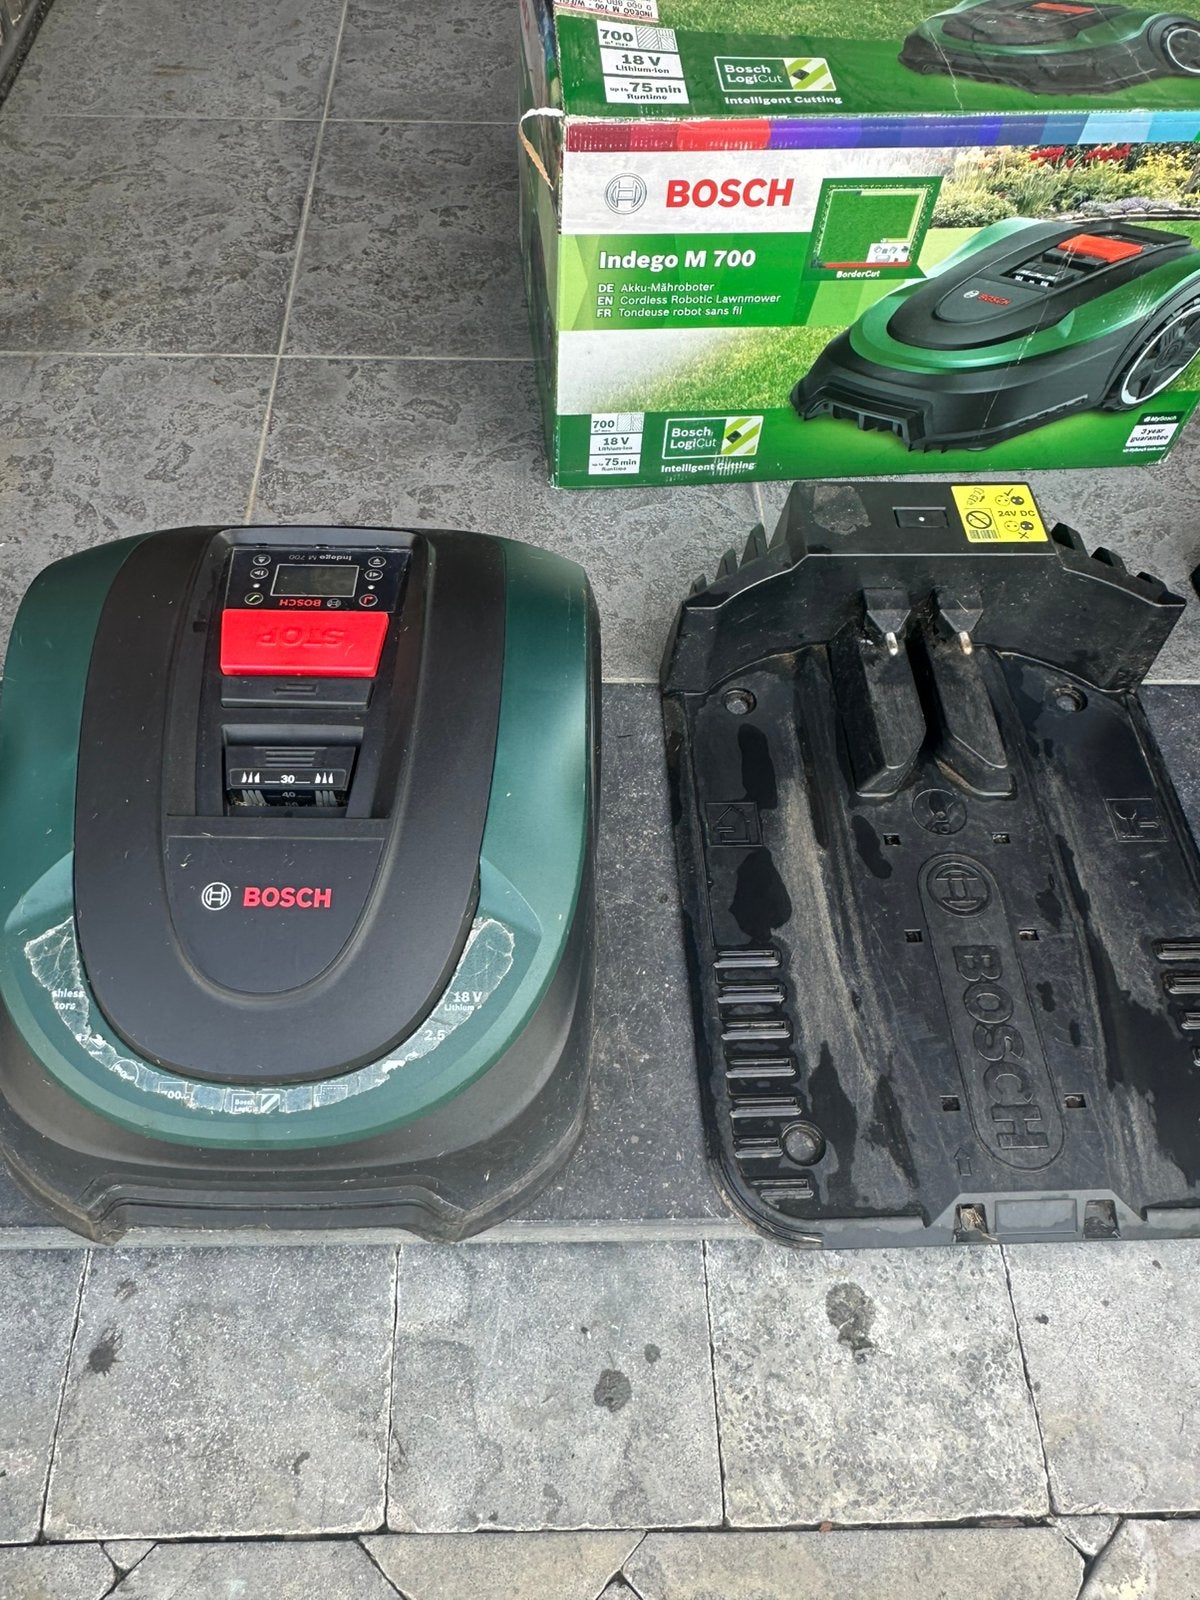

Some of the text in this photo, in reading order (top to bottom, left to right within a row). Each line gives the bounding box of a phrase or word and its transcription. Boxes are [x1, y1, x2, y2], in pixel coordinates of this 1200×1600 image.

[600, 29, 633, 42] 700
[621, 54, 661, 66] 18 V
[723, 63, 771, 75] Bosch
[726, 73, 783, 85] LogiCut
[629, 82, 653, 93] 75
[655, 85, 682, 94] min
[725, 95, 843, 106] Intelligent Cutting
[665, 178, 795, 208] BOSCH
[598, 249, 756, 273] Indego M 700
[836, 270, 881, 279] BorderCut
[598, 282, 715, 293] DE Akku-Mähroboter
[597, 294, 782, 306] EN Cordless Robotic Lawnmower
[597, 306, 743, 318] FR Tondeuse robot sans fil
[593, 420, 615, 429] 700
[671, 426, 711, 437] Bosch
[603, 437, 630, 446] 18 V
[670, 438, 717, 450] LogiCut
[1130, 435, 1169, 443] guarantee
[605, 458, 619, 466] 75
[661, 461, 755, 473] Intelligent Cutting
[279, 599, 322, 607] BOSCH
[256, 626, 345, 647] STOP
[280, 774, 296, 784] 30
[243, 886, 332, 908] BOSCH
[453, 991, 483, 1003] 18 V
[423, 1029, 446, 1041] 2.5
[952, 945, 1049, 1149] BOSCH
